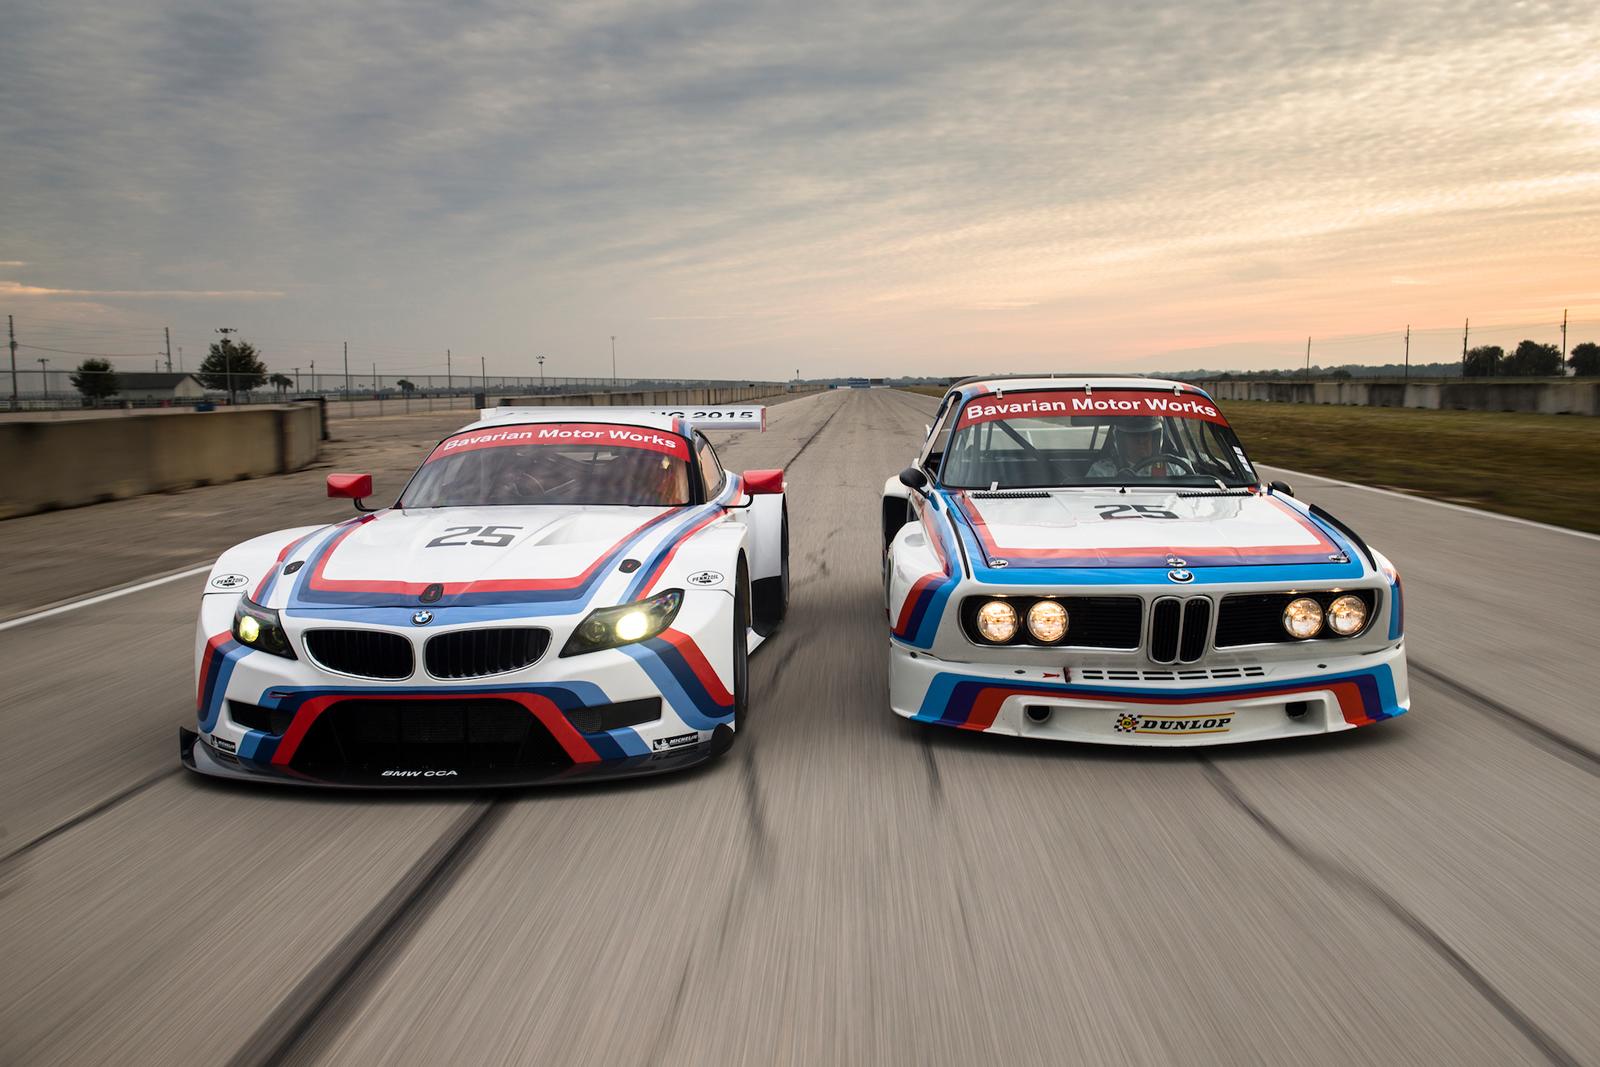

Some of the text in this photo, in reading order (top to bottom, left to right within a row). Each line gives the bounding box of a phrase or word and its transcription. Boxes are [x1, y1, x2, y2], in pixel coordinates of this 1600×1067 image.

[692, 411, 753, 419] 2015
[967, 398, 1217, 420] Bavarian Motor Works
[443, 429, 677, 451] Bavarian Motor Works
[1094, 504, 1180, 520] 25
[425, 526, 524, 548] 25
[1141, 718, 1231, 730] DUNLOP
